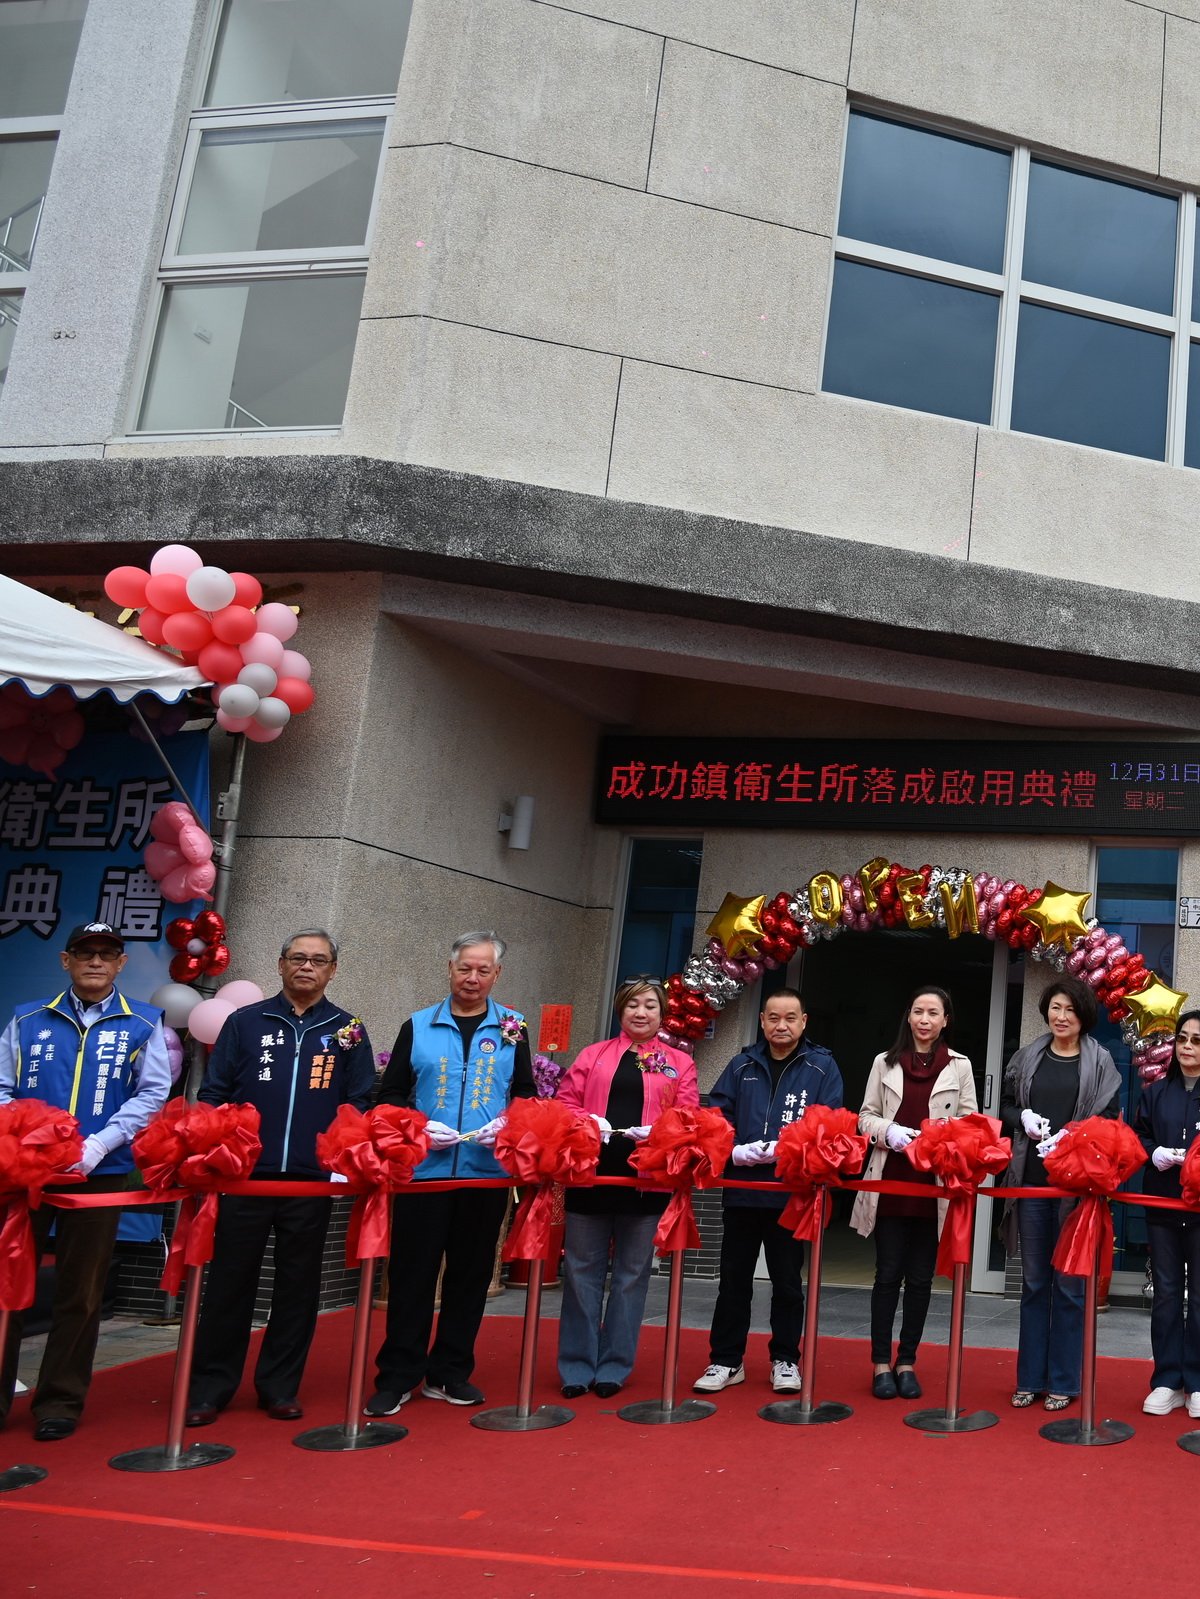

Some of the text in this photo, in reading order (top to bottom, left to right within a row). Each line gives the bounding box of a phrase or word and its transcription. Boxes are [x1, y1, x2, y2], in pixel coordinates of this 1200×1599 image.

[606, 761, 1097, 809] 成功鎮衛生所落成啟用典禮
[1109, 762, 1200, 783] 12月31日
[1123, 790, 1185, 811] 星期二
[45, 1044, 55, 1061] 主任
[276, 1029, 285, 1045] 主任
[27, 1044, 42, 1089] 陳正旭
[112, 1030, 130, 1079] 立法委員
[258, 1034, 276, 1081] 張永通
[321, 1055, 335, 1089] 立法委員
